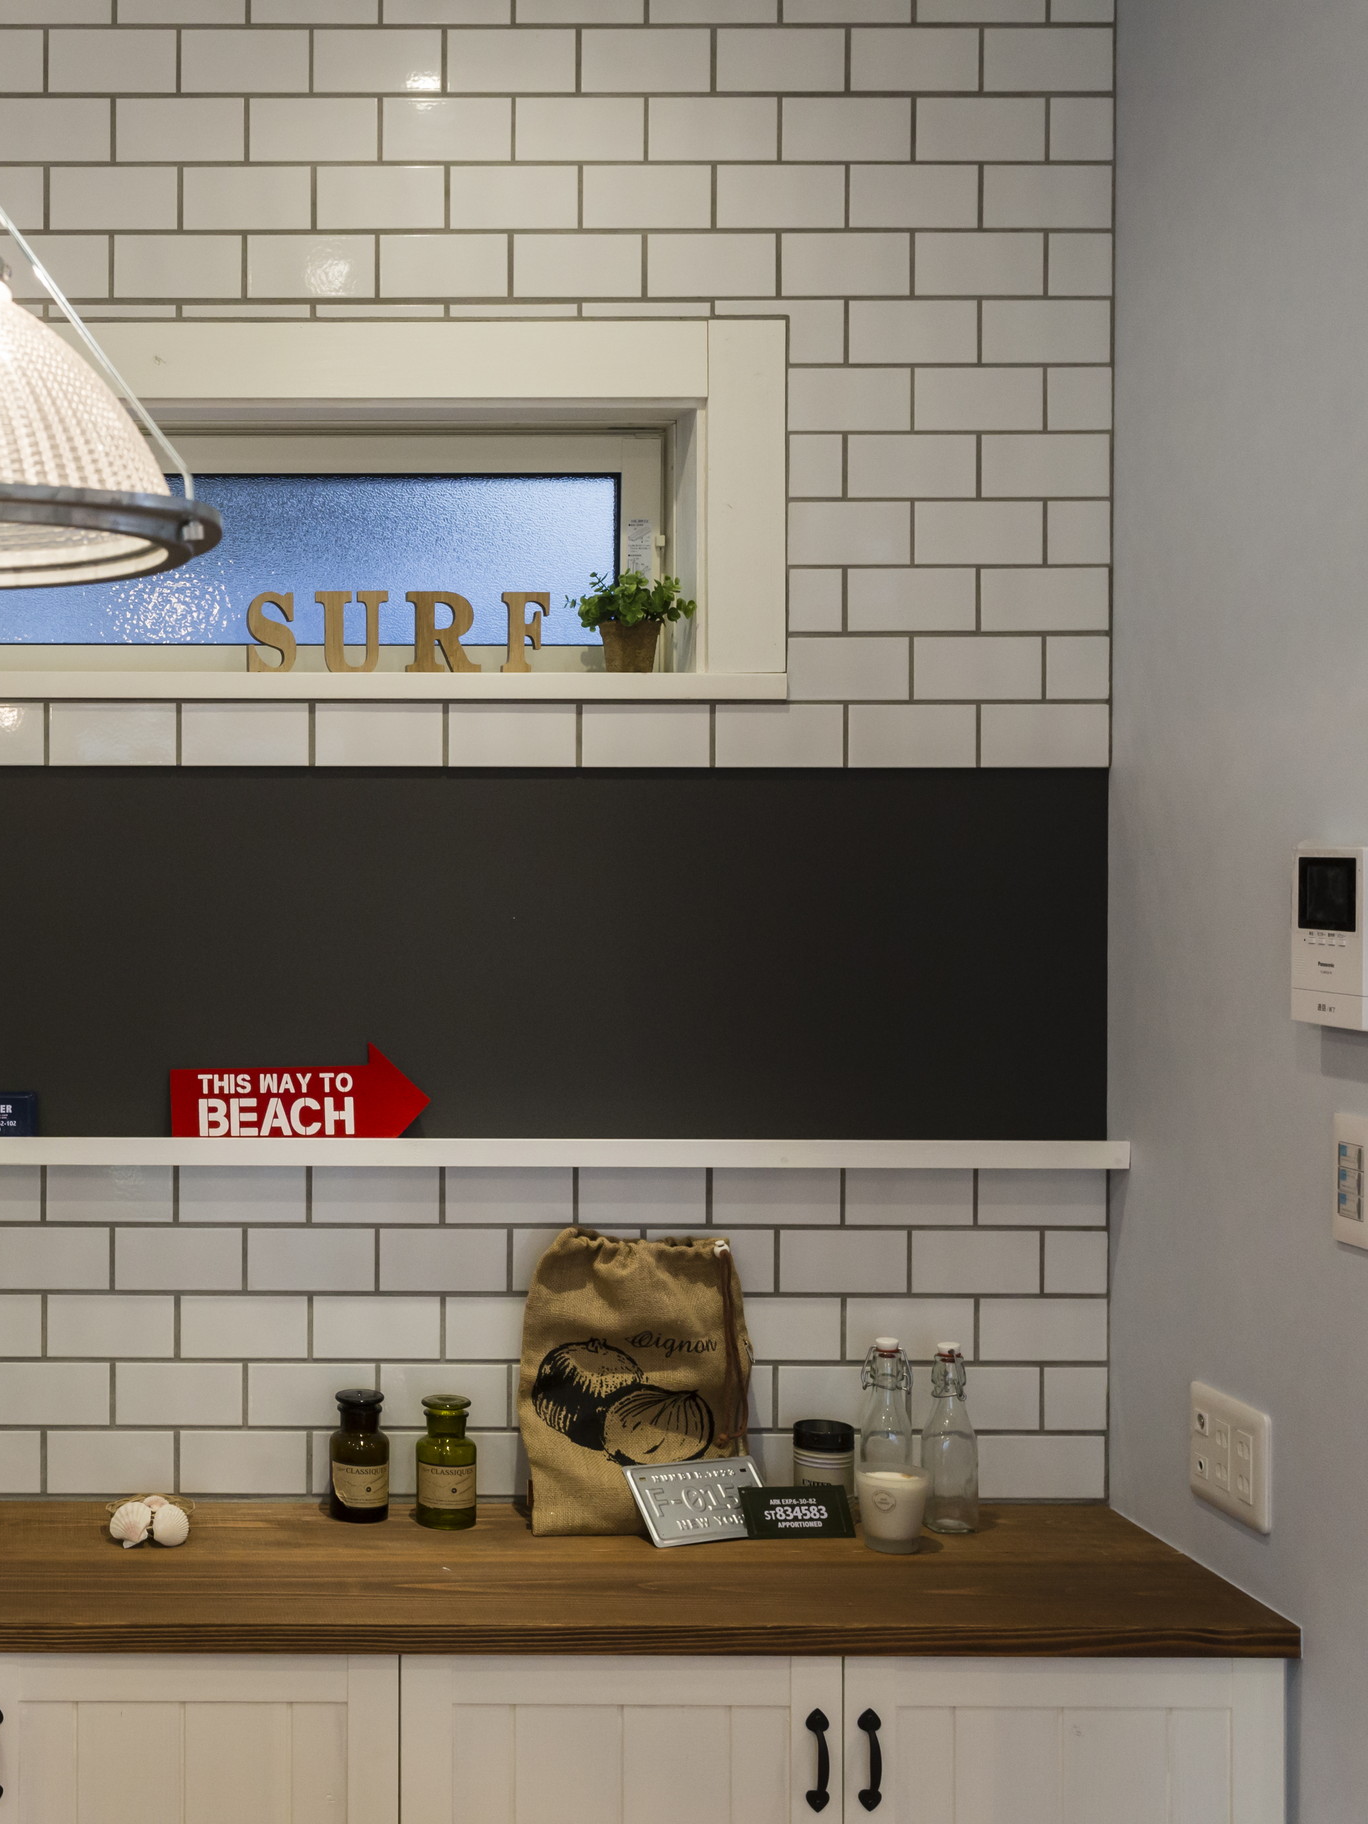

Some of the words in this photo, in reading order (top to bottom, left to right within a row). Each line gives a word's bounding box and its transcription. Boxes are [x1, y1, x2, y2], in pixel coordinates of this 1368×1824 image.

[246, 590, 551, 672] SURF
[197, 1073, 252, 1094] THIS
[259, 1073, 312, 1094] WAY
[319, 1072, 353, 1093] TO
[198, 1097, 355, 1137] BEACH
[625, 1331, 717, 1358] Oignon
[430, 1468, 473, 1476] CLASSIQUES
[676, 1517, 711, 1530] NEW
[713, 1514, 745, 1526] YOR
[778, 1520, 823, 1528] APPORTIONED
